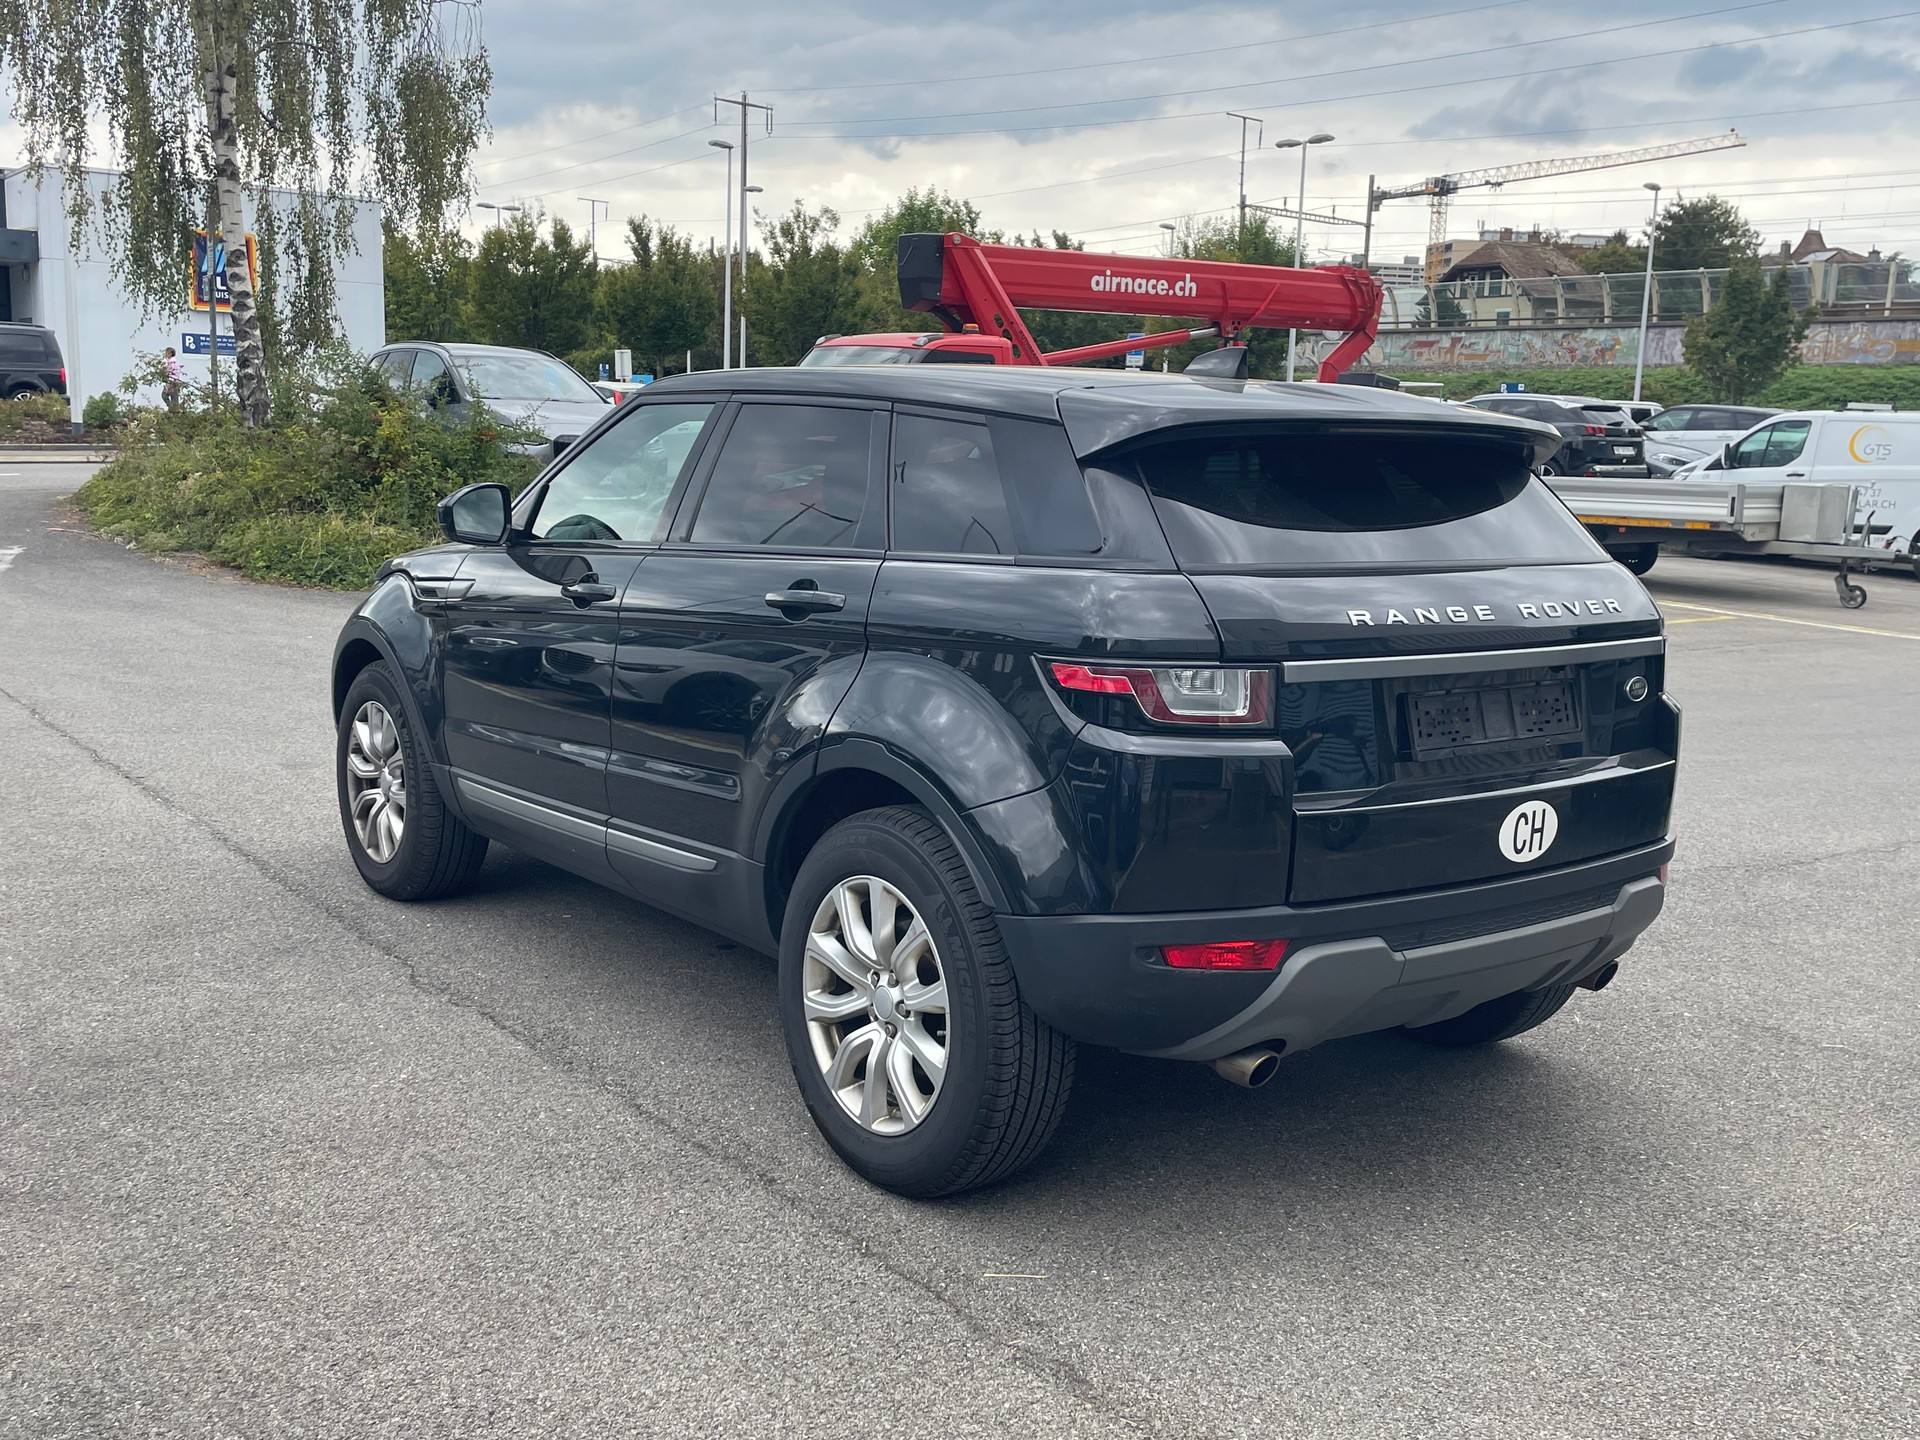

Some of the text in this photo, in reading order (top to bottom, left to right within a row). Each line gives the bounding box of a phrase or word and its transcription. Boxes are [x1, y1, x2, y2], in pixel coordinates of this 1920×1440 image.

[1090, 268, 1197, 297] airnace.ch
[1863, 443, 1893, 456] GTS
[1347, 598, 1623, 626] RANGE ROVER
[1513, 808, 1546, 855] CH
